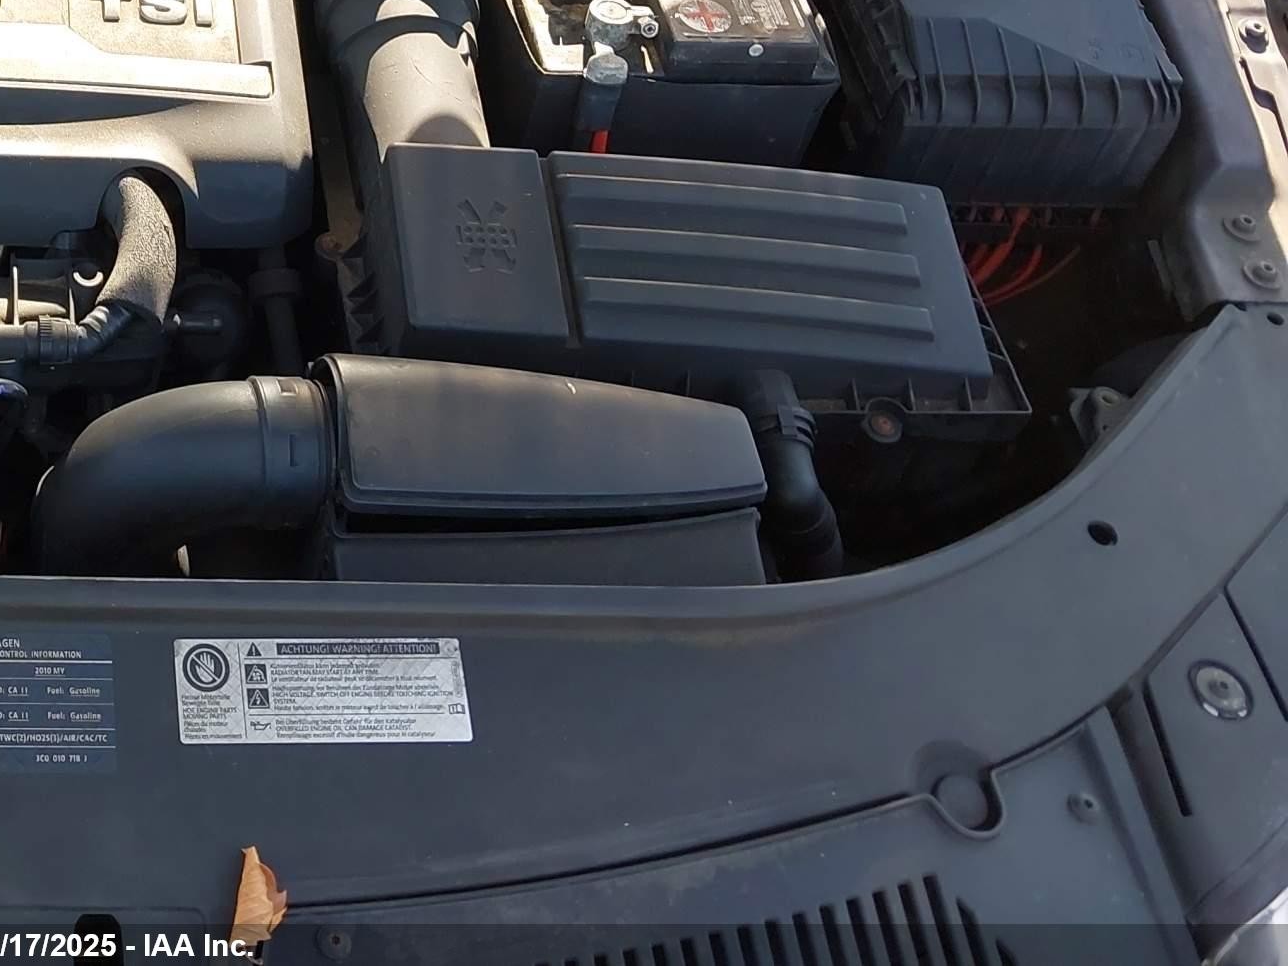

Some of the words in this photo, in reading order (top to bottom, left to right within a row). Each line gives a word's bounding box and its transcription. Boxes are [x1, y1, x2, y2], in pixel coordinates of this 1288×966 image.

[280, 644, 330, 654] ACHTUNG!
[332, 644, 380, 653] WARNING!
[382, 644, 436, 653] ATTENTION!
[31, 650, 82, 659] INFORMATION
[34, 667, 52, 675] 2010
